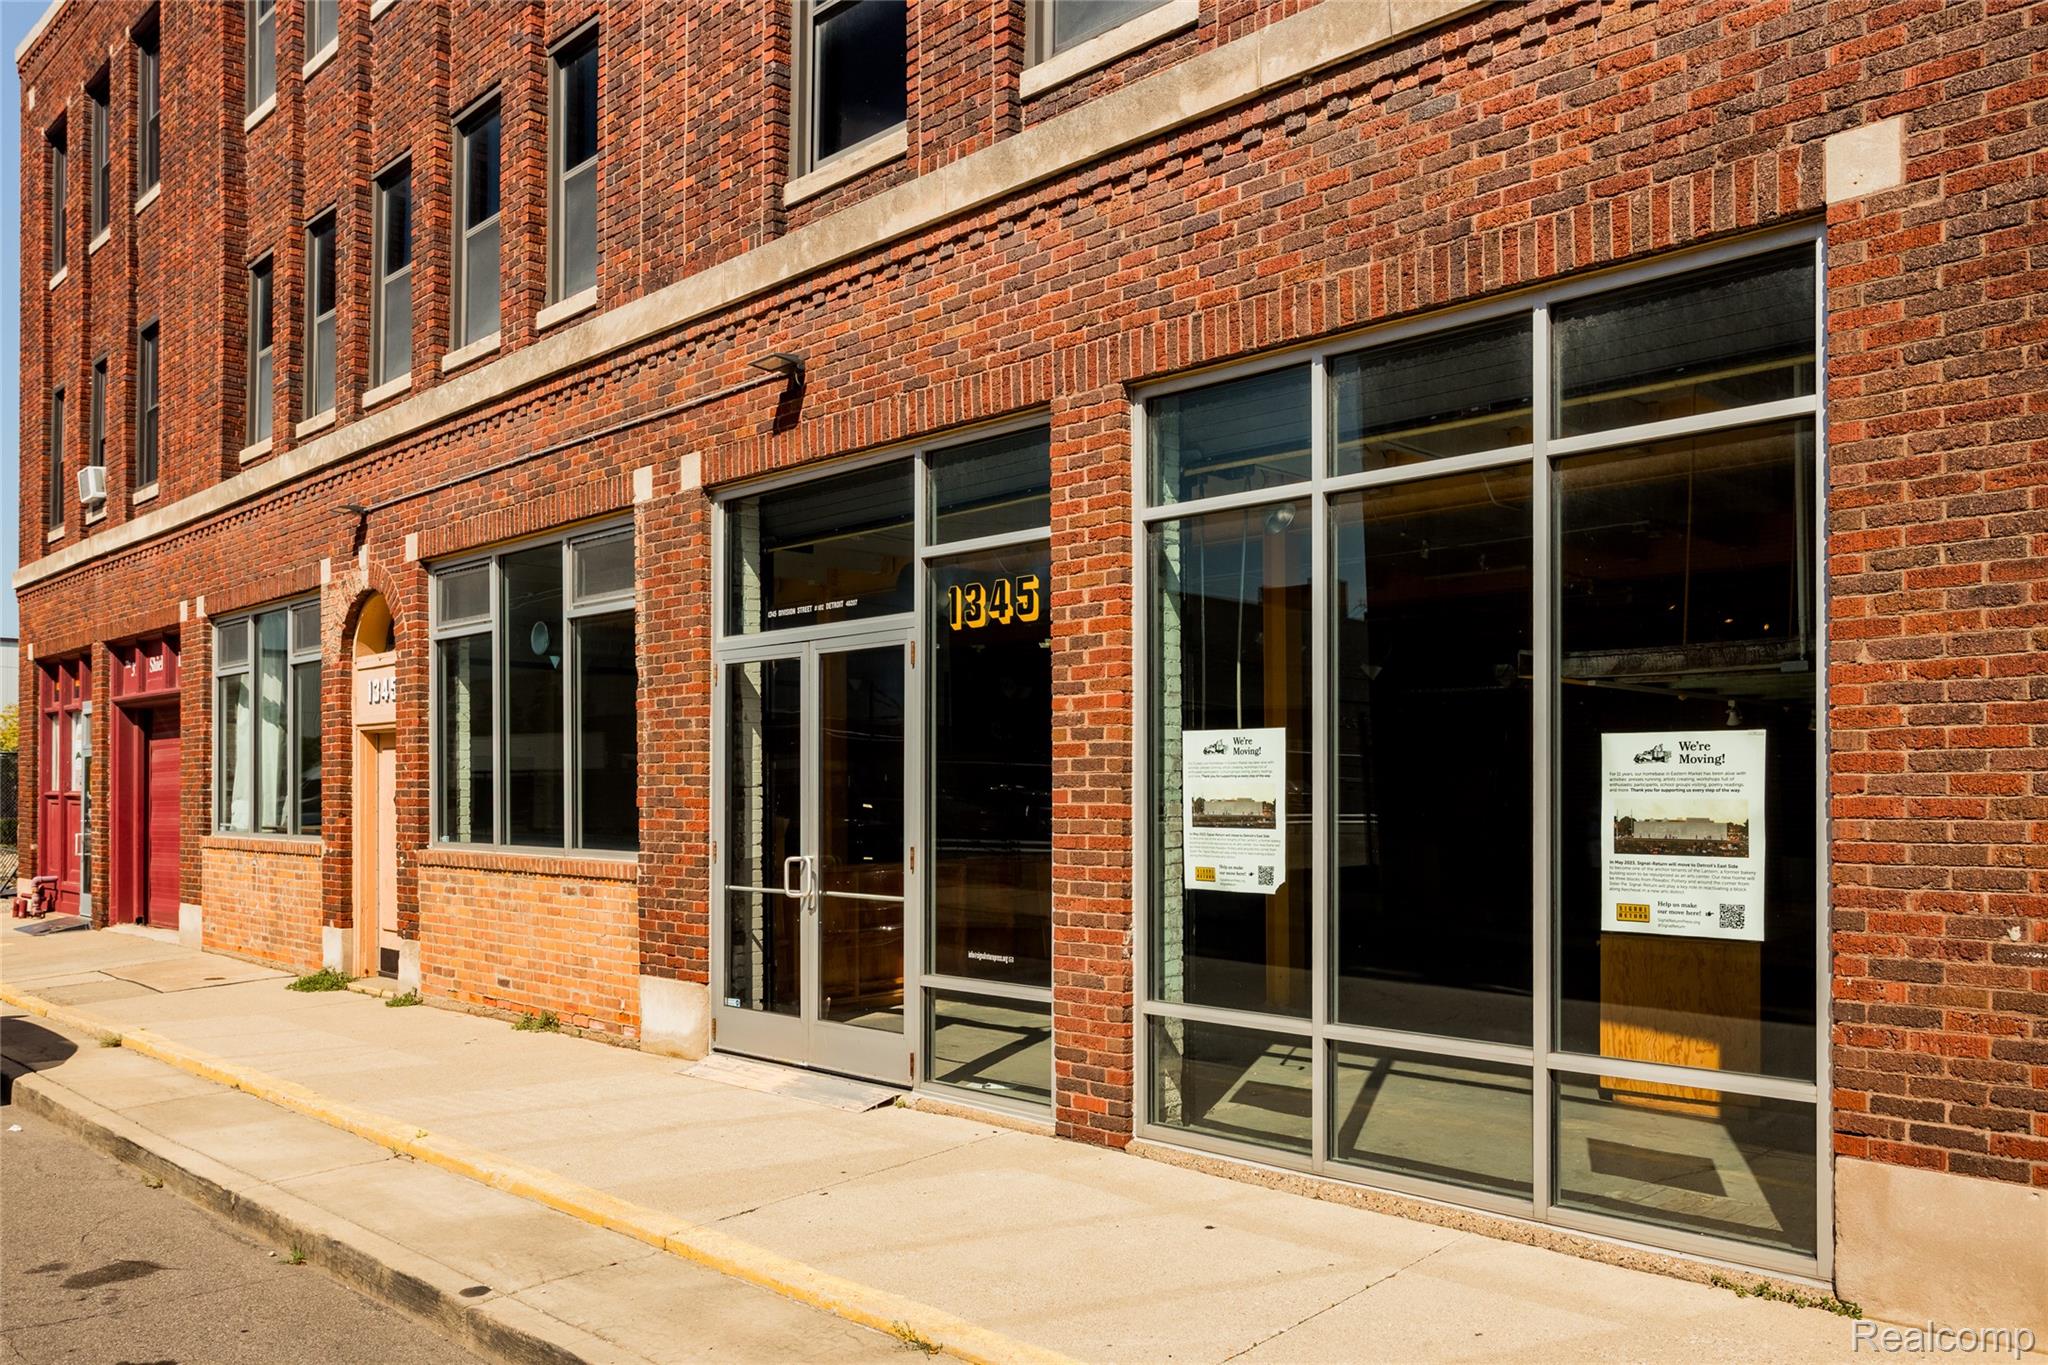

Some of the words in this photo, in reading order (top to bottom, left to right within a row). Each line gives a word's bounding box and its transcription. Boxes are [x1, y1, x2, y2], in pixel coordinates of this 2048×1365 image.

[778, 608, 796, 616] DIVISION
[797, 605, 813, 614] STREET
[826, 600, 844, 610] DETROIT
[948, 574, 1039, 631] 1345
[1232, 737, 1253, 745] We're
[1679, 741, 1711, 751] We're
[1233, 747, 1262, 756] Moving!
[1679, 754, 1726, 766] Moving!
